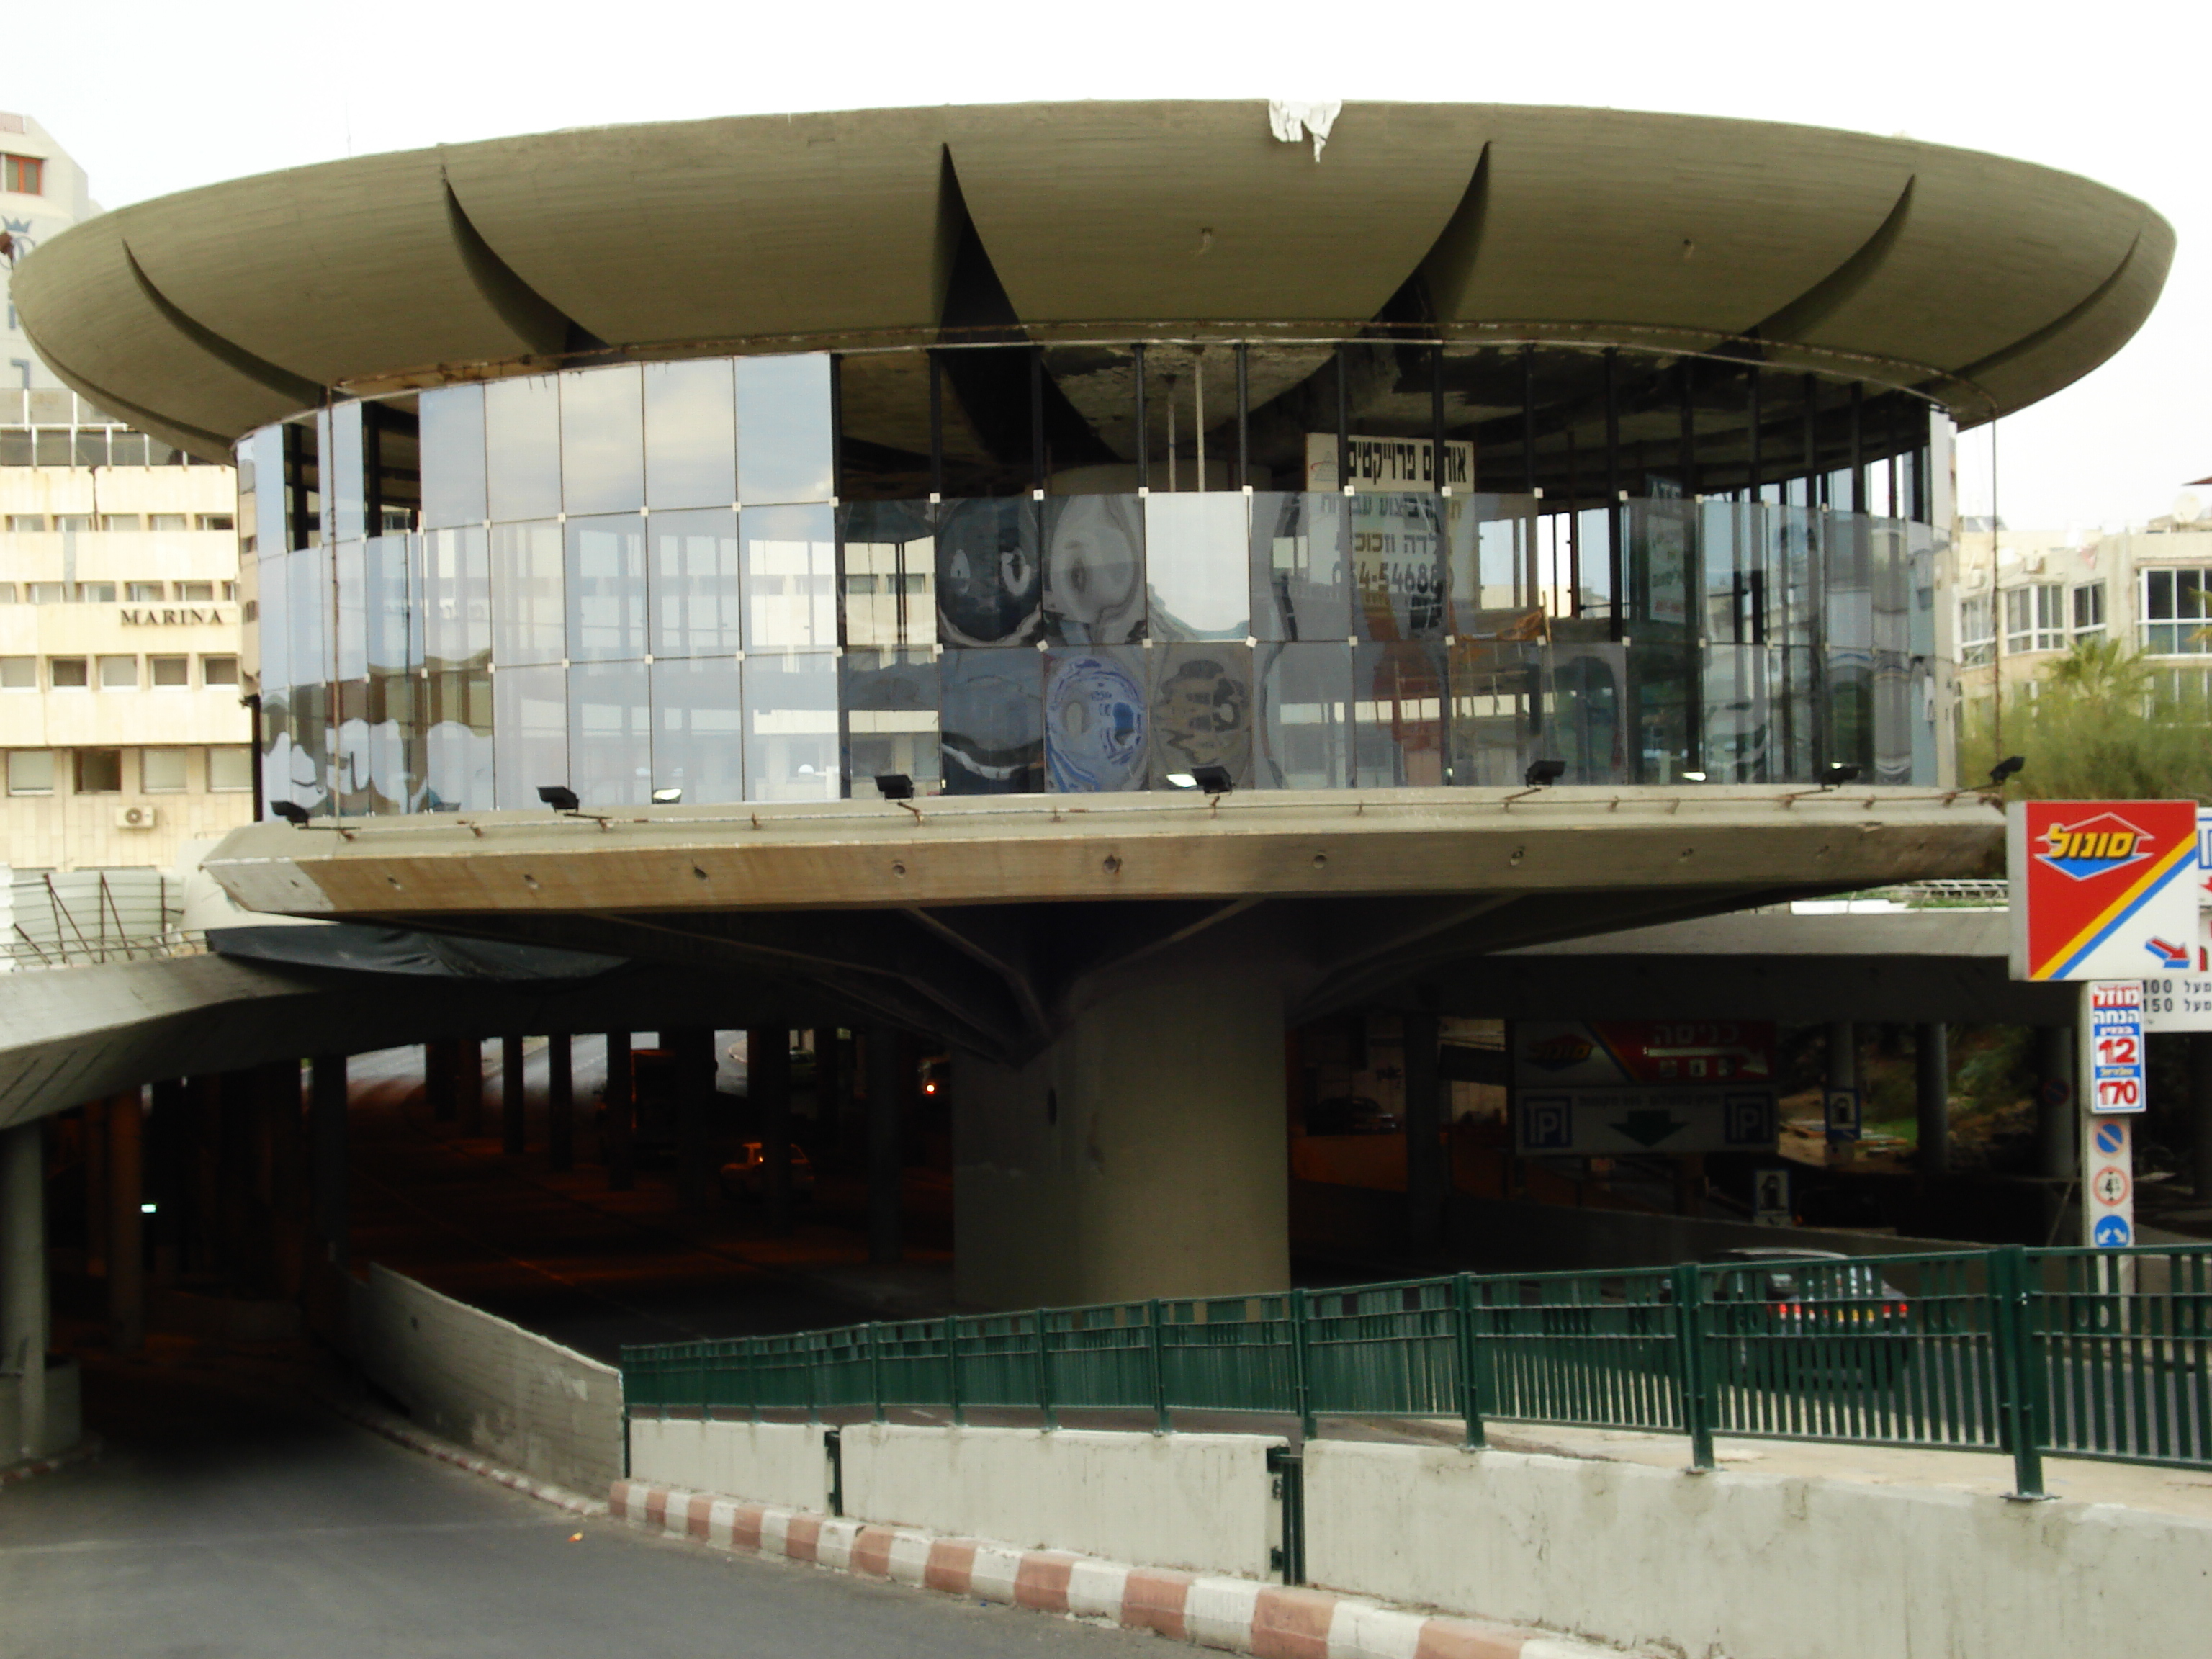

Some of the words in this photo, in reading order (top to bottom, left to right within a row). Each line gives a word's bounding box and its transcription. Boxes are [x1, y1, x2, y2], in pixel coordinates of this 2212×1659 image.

[1424, 444, 1467, 483] אורם
[121, 609, 223, 626] MARINA
[2049, 824, 2137, 860] סונול
[2093, 1010, 2139, 1025] הנחה
[1652, 1023, 1740, 1046] כניסה
[2098, 1037, 2136, 1064] 12
[2098, 1080, 2138, 1105] 170
